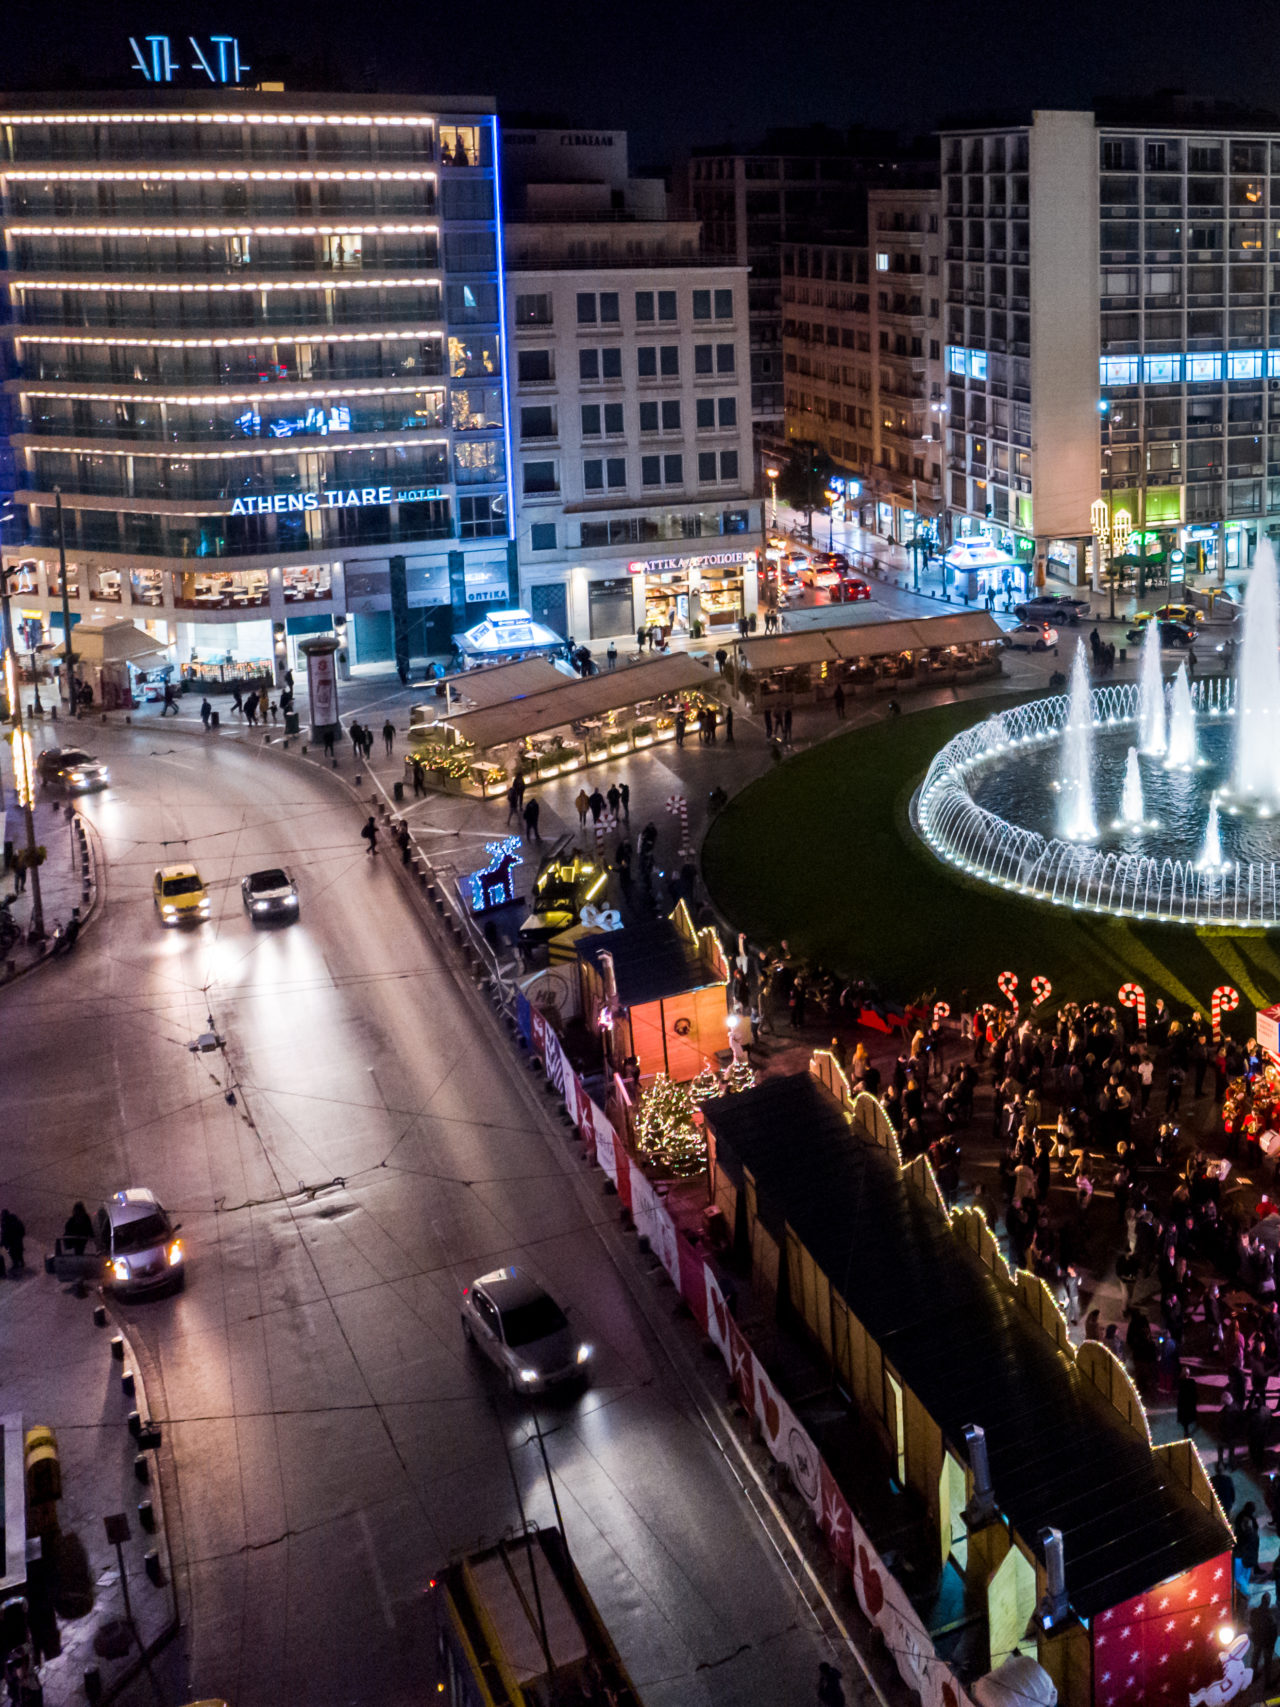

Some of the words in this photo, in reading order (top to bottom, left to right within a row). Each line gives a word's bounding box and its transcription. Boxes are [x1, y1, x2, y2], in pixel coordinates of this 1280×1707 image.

[230, 493, 319, 516] ATHENS
[324, 486, 393, 509] TIARE
[397, 488, 442, 503] HOTEL
